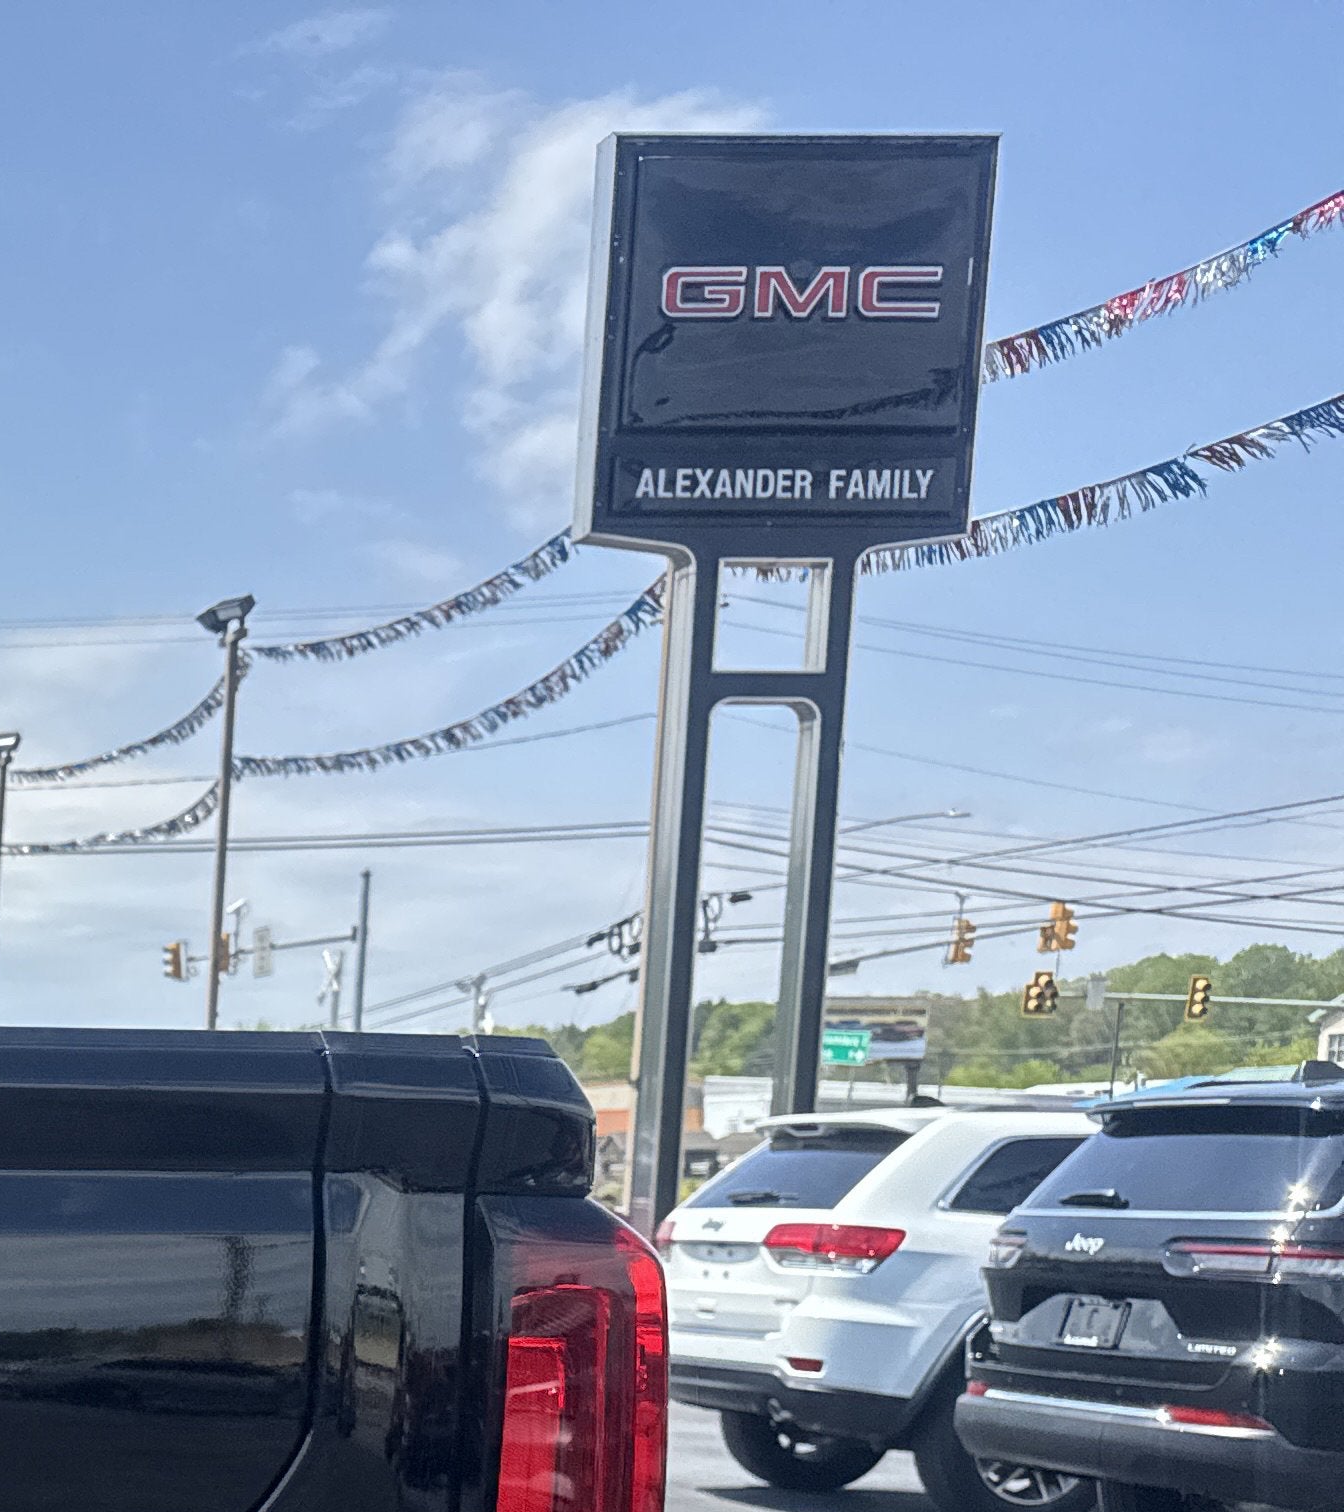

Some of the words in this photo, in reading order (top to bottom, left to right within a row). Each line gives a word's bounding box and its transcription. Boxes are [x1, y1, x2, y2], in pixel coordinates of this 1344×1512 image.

[662, 266, 943, 317] GMC
[635, 468, 812, 499] ALEXANDER
[828, 469, 933, 499] FAMILY
